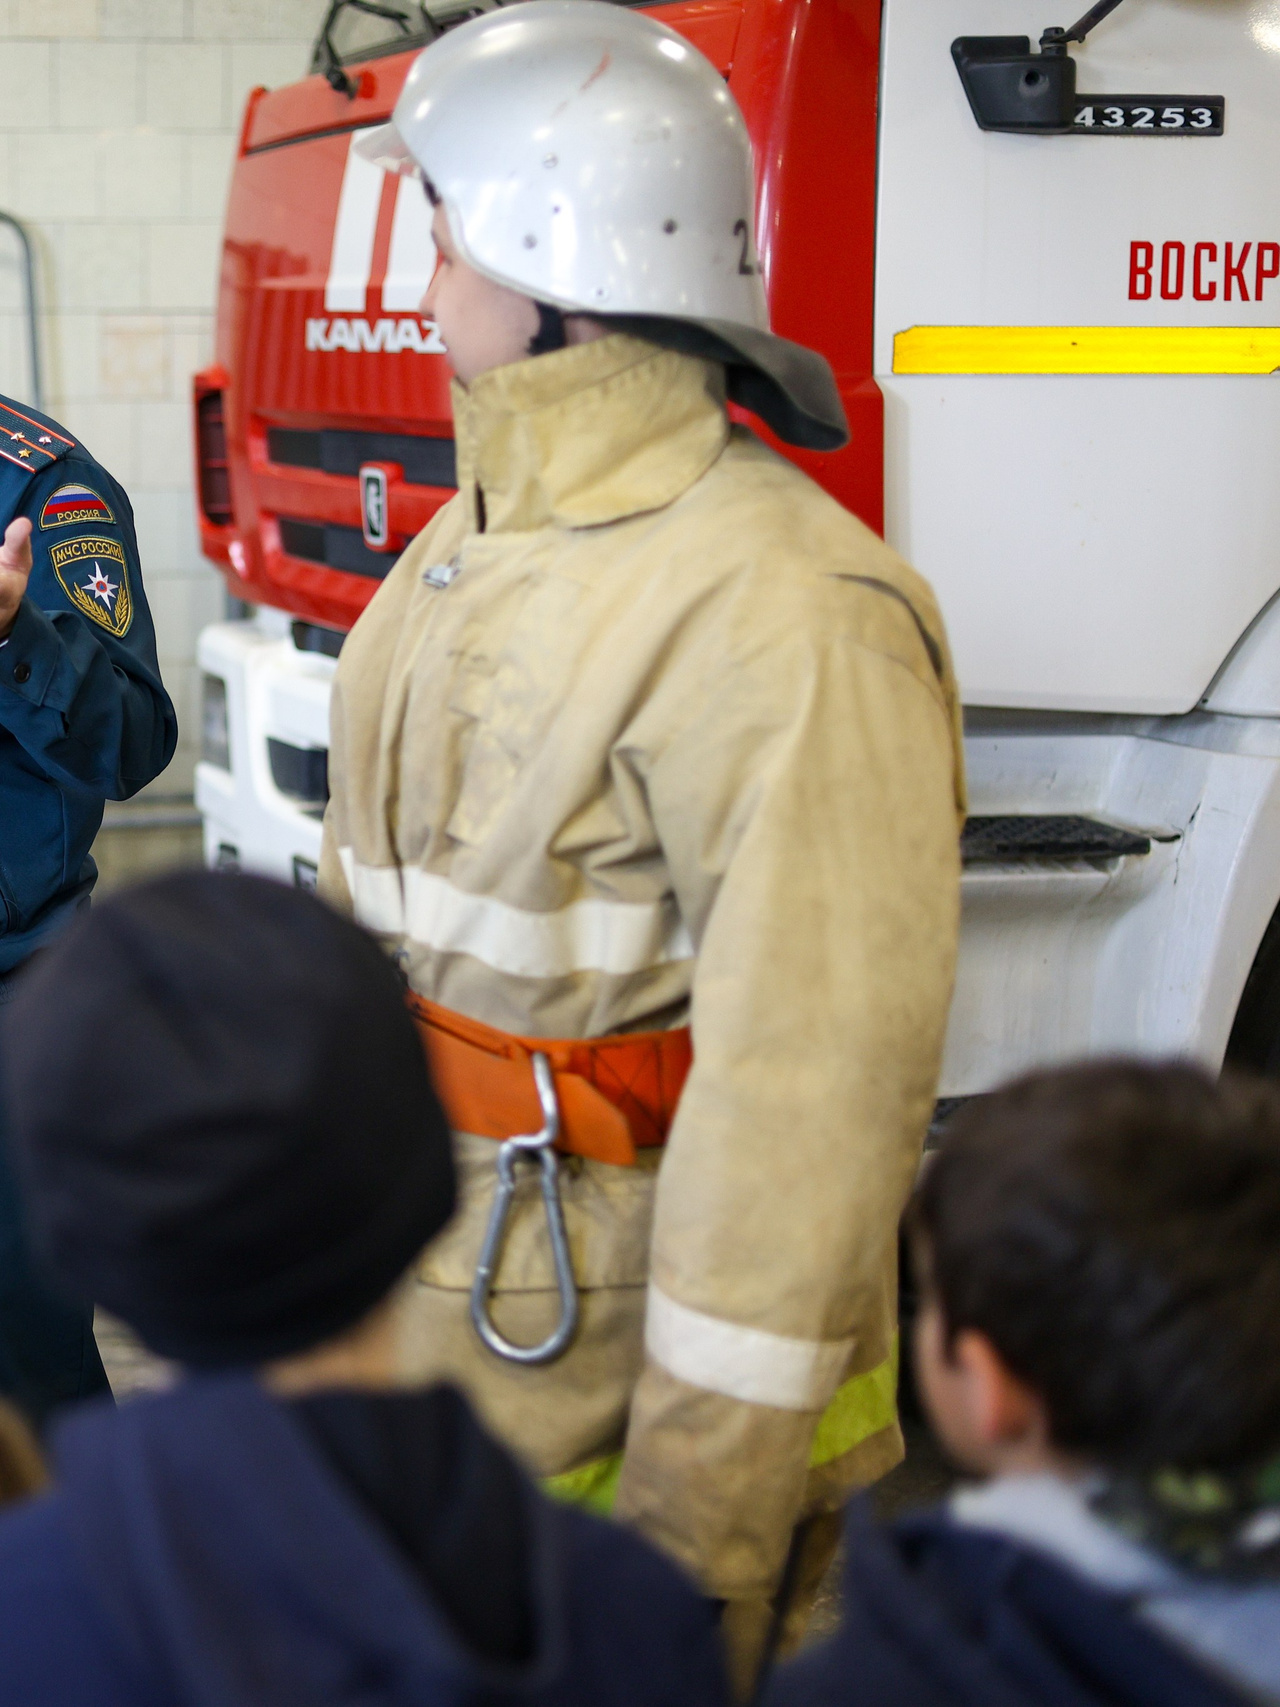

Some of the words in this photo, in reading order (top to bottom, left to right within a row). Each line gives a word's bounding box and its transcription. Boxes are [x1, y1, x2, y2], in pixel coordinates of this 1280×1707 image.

[1074, 106, 1213, 128] 43253
[1128, 240, 1280, 301] ВОСКР
[305, 317, 448, 354] KAMAZ
[56, 509, 100, 522] РОССИЯ
[56, 544, 81, 563] МЧС
[81, 541, 121, 558] РОССИИ
